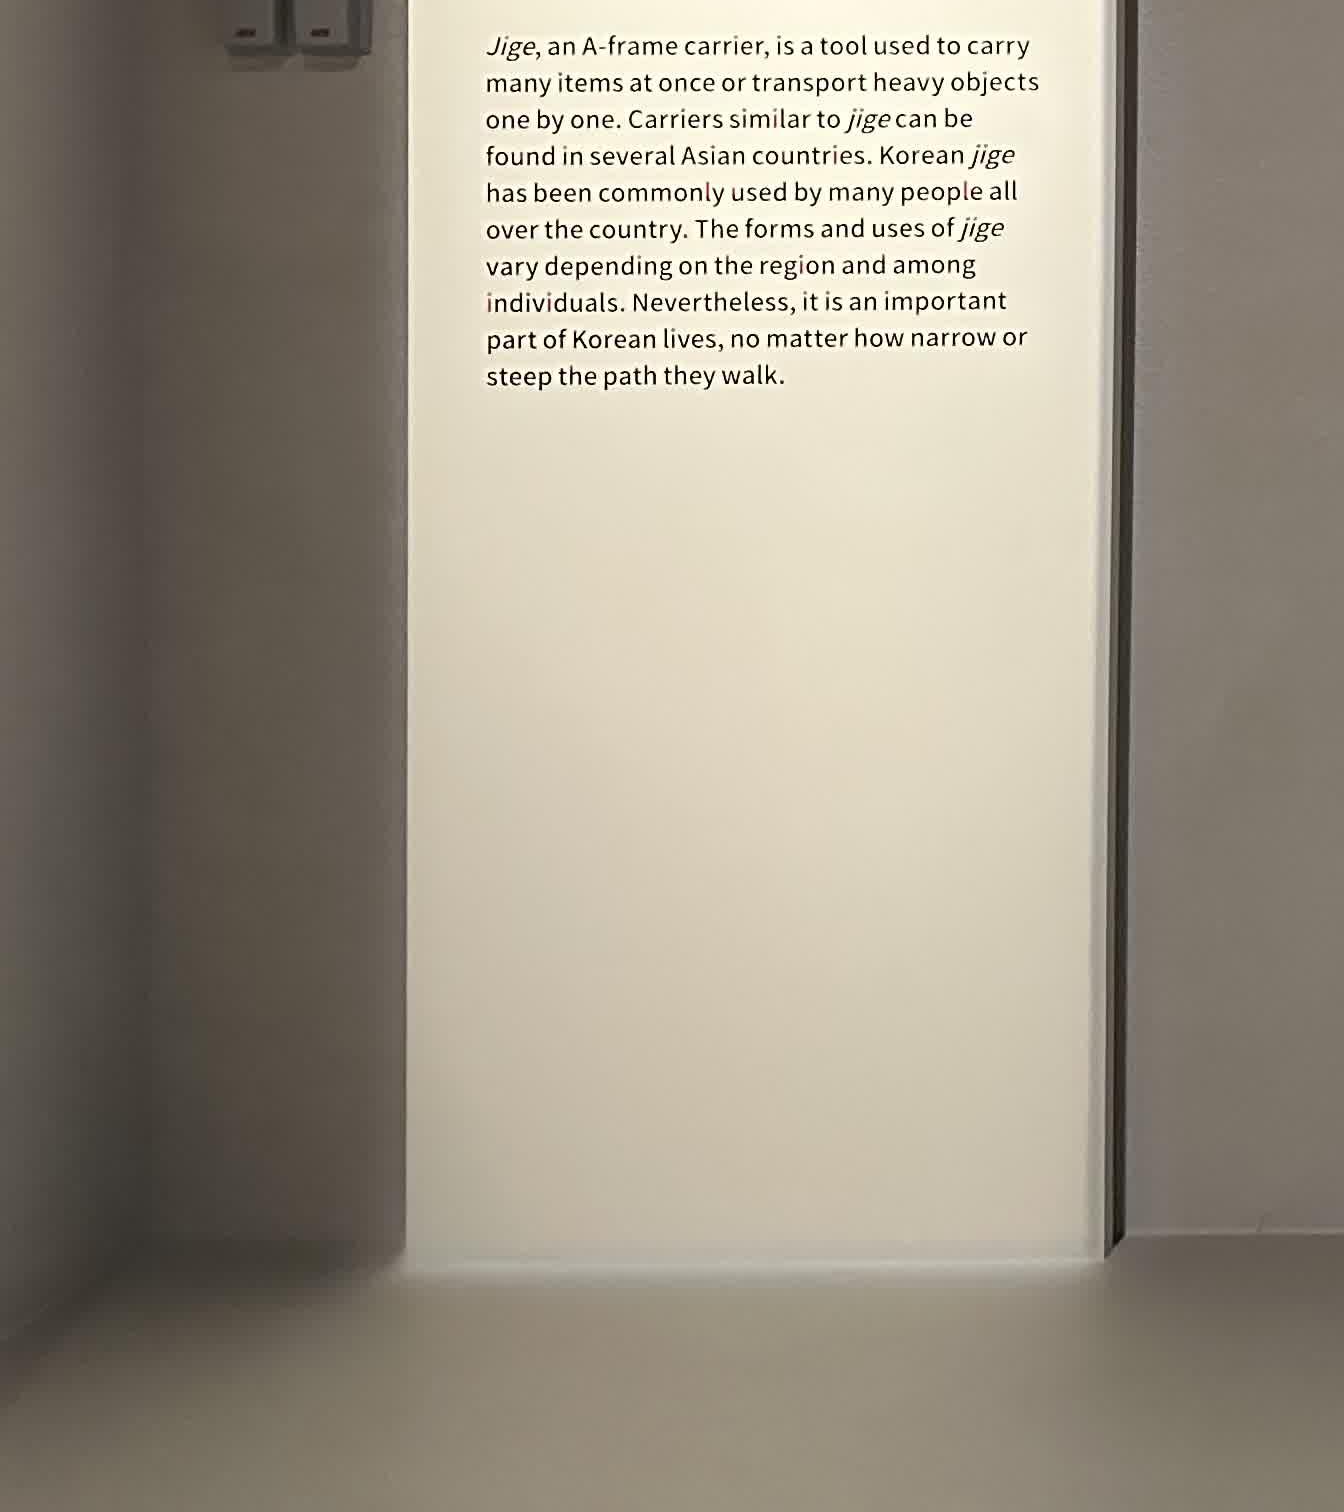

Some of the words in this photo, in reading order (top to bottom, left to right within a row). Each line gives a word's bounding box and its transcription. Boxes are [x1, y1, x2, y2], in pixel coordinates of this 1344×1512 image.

[485, 35, 541, 62] Jige,
[547, 40, 576, 57] an
[581, 34, 679, 57] A-frame
[684, 34, 770, 60] carrier,
[776, 34, 795, 56] is
[800, 40, 813, 56] a
[819, 33, 868, 56] tool
[873, 33, 930, 56] used
[936, 36, 961, 56] to
[967, 39, 1030, 61] carry
[486, 77, 553, 99] many
[557, 71, 624, 94] items
[629, 73, 654, 93] at
[658, 77, 716, 93] once
[721, 76, 747, 93] or
[751, 73, 868, 98] transport
[873, 71, 945, 97] heavy
[950, 70, 1040, 97] objects
[485, 113, 531, 131] one
[536, 107, 565, 135] by
[570, 113, 622, 130] one.
[628, 107, 724, 129] Carriers
[729, 107, 812, 129] similar
[816, 109, 841, 130] to
[844, 107, 893, 135] jige
[895, 112, 937, 130] can
[944, 107, 975, 129] be
[485, 144, 556, 167] found
[562, 144, 583, 167] in
[589, 143, 676, 166] several
[680, 144, 745, 166] Asian
[752, 144, 873, 166] countries.
[879, 145, 964, 166] Korean
[967, 143, 1016, 171] jige
[487, 181, 528, 204] has
[533, 181, 592, 204] been
[598, 180, 725, 208] commonly
[731, 180, 787, 202] used
[794, 180, 823, 209] by
[828, 186, 895, 207] many
[901, 179, 984, 207] people
[989, 179, 1018, 201] all
[485, 223, 540, 240] over
[543, 217, 584, 240] the
[589, 219, 689, 245] country.
[693, 217, 739, 240] The
[744, 217, 815, 239] forms
[820, 216, 866, 240] and
[872, 222, 925, 238] uses
[931, 216, 955, 238] of
[956, 216, 1006, 244] jige
[485, 260, 539, 282] vary
[544, 254, 673, 282] depending
[678, 260, 708, 277] on
[713, 254, 753, 276] the
[759, 254, 836, 281] region
[841, 253, 886, 275] and
[893, 258, 977, 280] among
[486, 291, 625, 313] individuals.
[632, 290, 796, 317] Nevertheless,
[802, 290, 819, 312] it
[825, 290, 843, 312] is
[848, 295, 877, 312] an
[884, 290, 1008, 317] important
[487, 331, 538, 356] part
[543, 327, 568, 353] of
[572, 329, 657, 350] Korean
[663, 327, 724, 353] lives,
[730, 333, 760, 349] no
[767, 329, 849, 349] matter
[854, 327, 905, 349] how
[911, 330, 997, 348] narrow
[1002, 330, 1029, 347] or
[485, 367, 553, 392] steep
[557, 364, 598, 387] the
[603, 363, 657, 392] path
[663, 363, 718, 391] they
[721, 363, 785, 385] walk.
